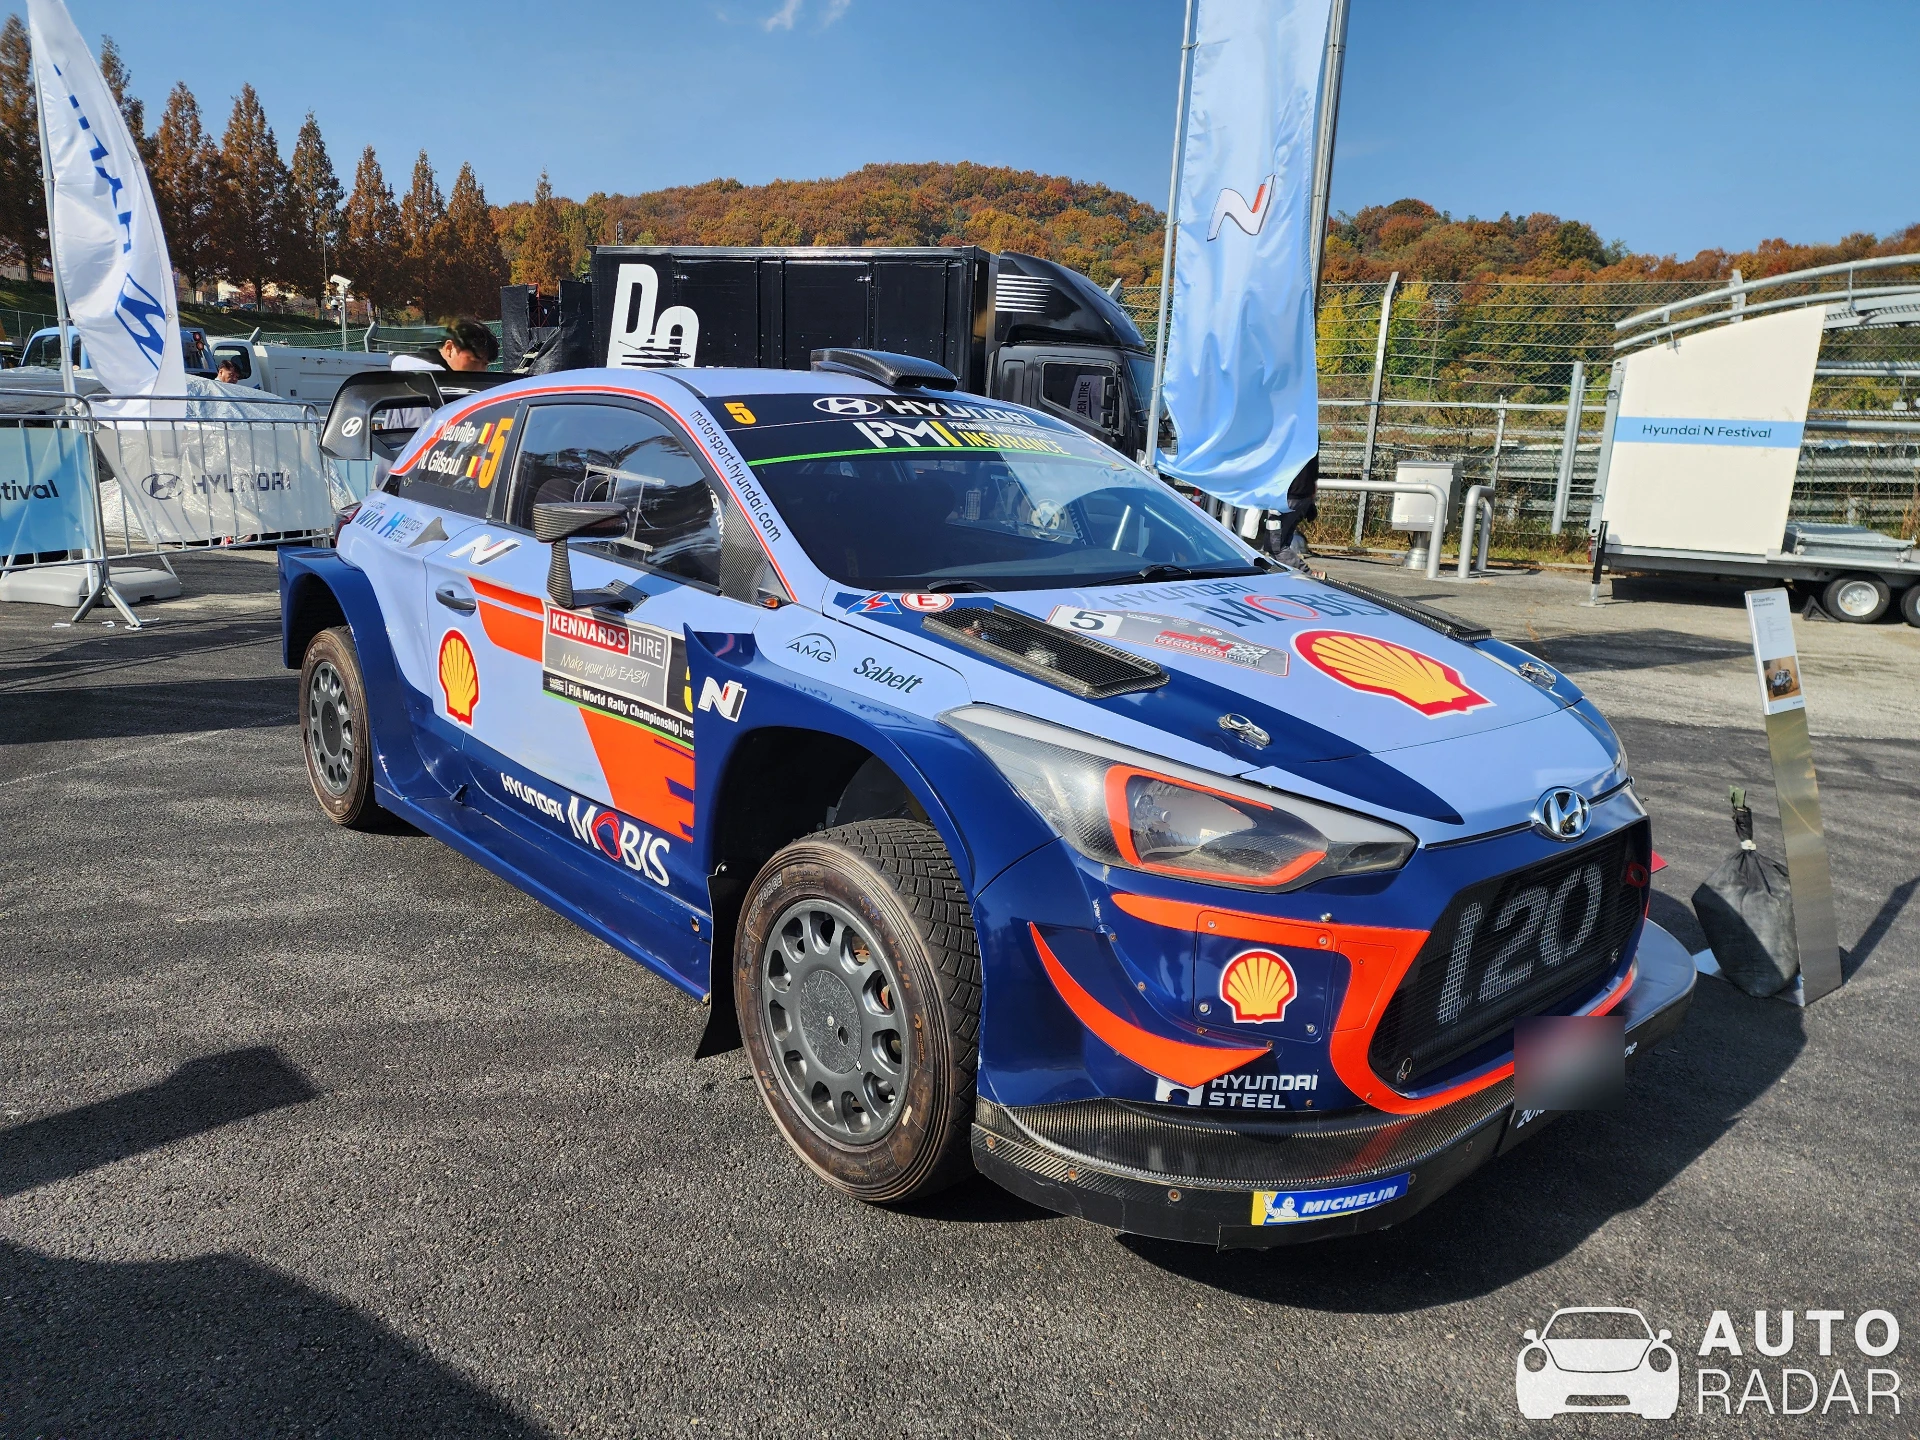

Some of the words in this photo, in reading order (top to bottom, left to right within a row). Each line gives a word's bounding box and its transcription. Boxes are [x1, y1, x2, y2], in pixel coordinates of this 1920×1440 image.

[724, 402, 757, 425] 5
[884, 400, 1038, 426] HYUNDAI
[440, 420, 476, 443] Neuville
[853, 420, 963, 448] PMI
[949, 421, 994, 432] PREMIUM
[1642, 424, 1700, 436] Hyundai
[1703, 426, 1714, 437] N
[1717, 426, 1772, 438] Festival
[478, 417, 514, 489] 5
[958, 431, 1071, 456] INSURANCE
[428, 449, 464, 476] Gilsoul
[690, 410, 782, 542] motorsport.hyundai.com
[0, 479, 59, 500] tival
[917, 594, 935, 607] E
[1069, 611, 1107, 631] 5
[552, 613, 627, 650] KENNARDS
[632, 633, 663, 660] HIRE
[560, 653, 583, 672] Make
[785, 641, 833, 663] AMG
[853, 657, 924, 694] Sabelt
[568, 684, 582, 699] FIA
[582, 688, 606, 707] World
[607, 696, 630, 716] Rally
[629, 703, 680, 736] Championship
[501, 771, 566, 824] HYUNDAI
[567, 795, 671, 887] MOBIS
[1211, 1074, 1319, 1091] HYUNDAI
[1208, 1093, 1287, 1110] STEEL
[1301, 1185, 1399, 1214] MICHELIN
